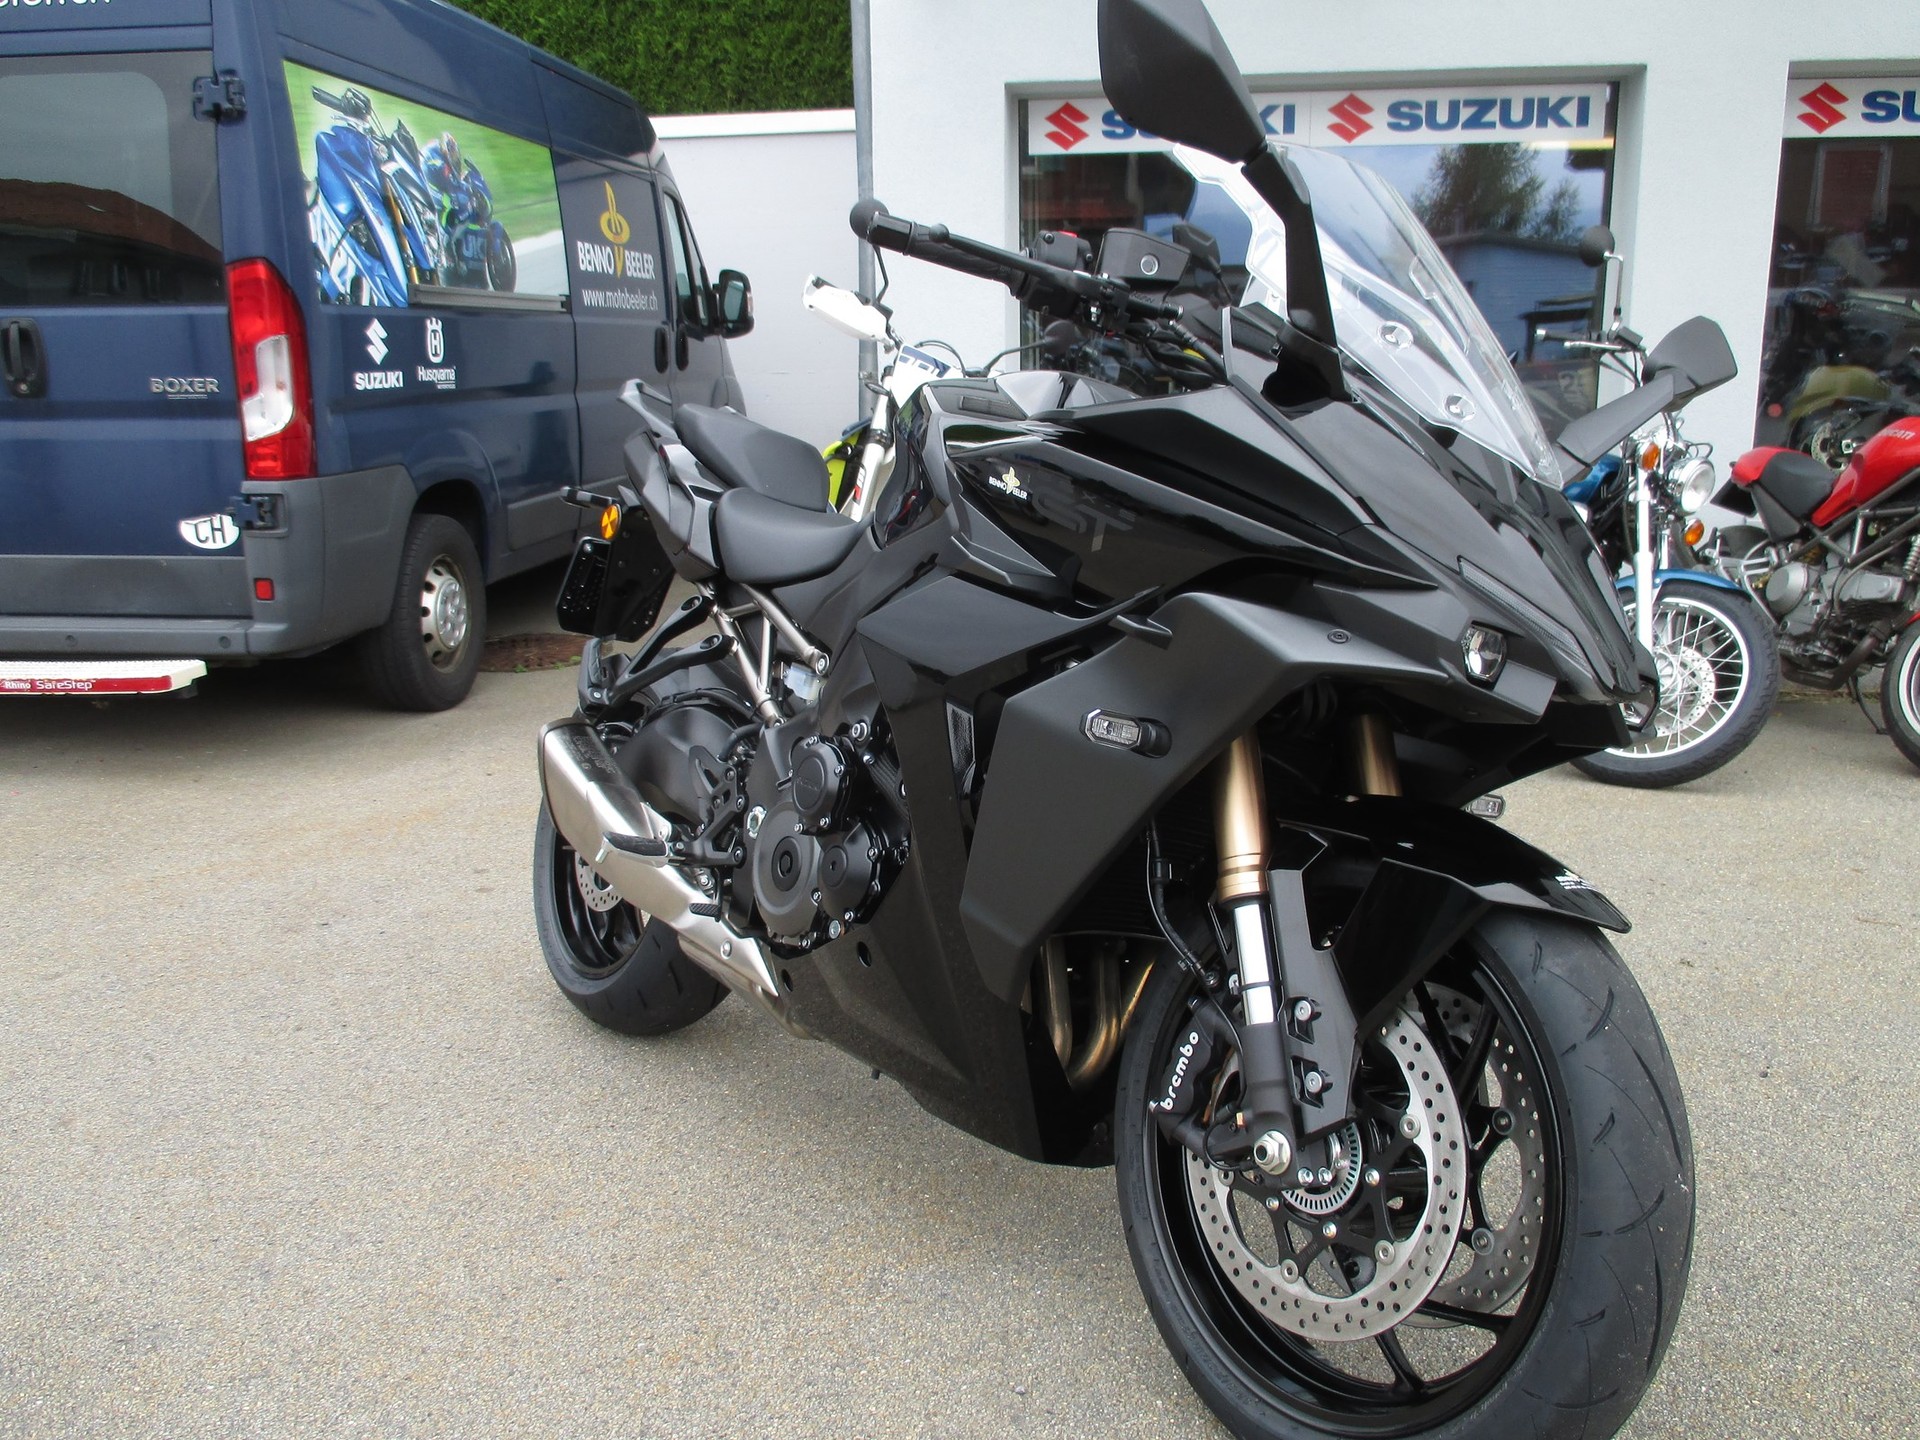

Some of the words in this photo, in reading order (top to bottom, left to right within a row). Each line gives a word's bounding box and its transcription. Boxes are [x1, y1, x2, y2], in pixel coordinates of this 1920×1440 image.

[1101, 104, 1296, 140] SKI
[1386, 96, 1591, 132] SUZUKI
[577, 241, 615, 275] BENNO
[625, 249, 656, 280] BEELER
[582, 287, 658, 311] www.motobeeler.ch
[150, 378, 220, 393] BOXER
[354, 371, 404, 391] SUZUKI
[417, 366, 456, 382] Husqvarna
[1010, 486, 1028, 500] EELER
[194, 516, 227, 544] CH
[4, 680, 31, 689] Rhino
[36, 680, 93, 691] SafeStep
[1160, 1032, 1199, 1110] brembo
